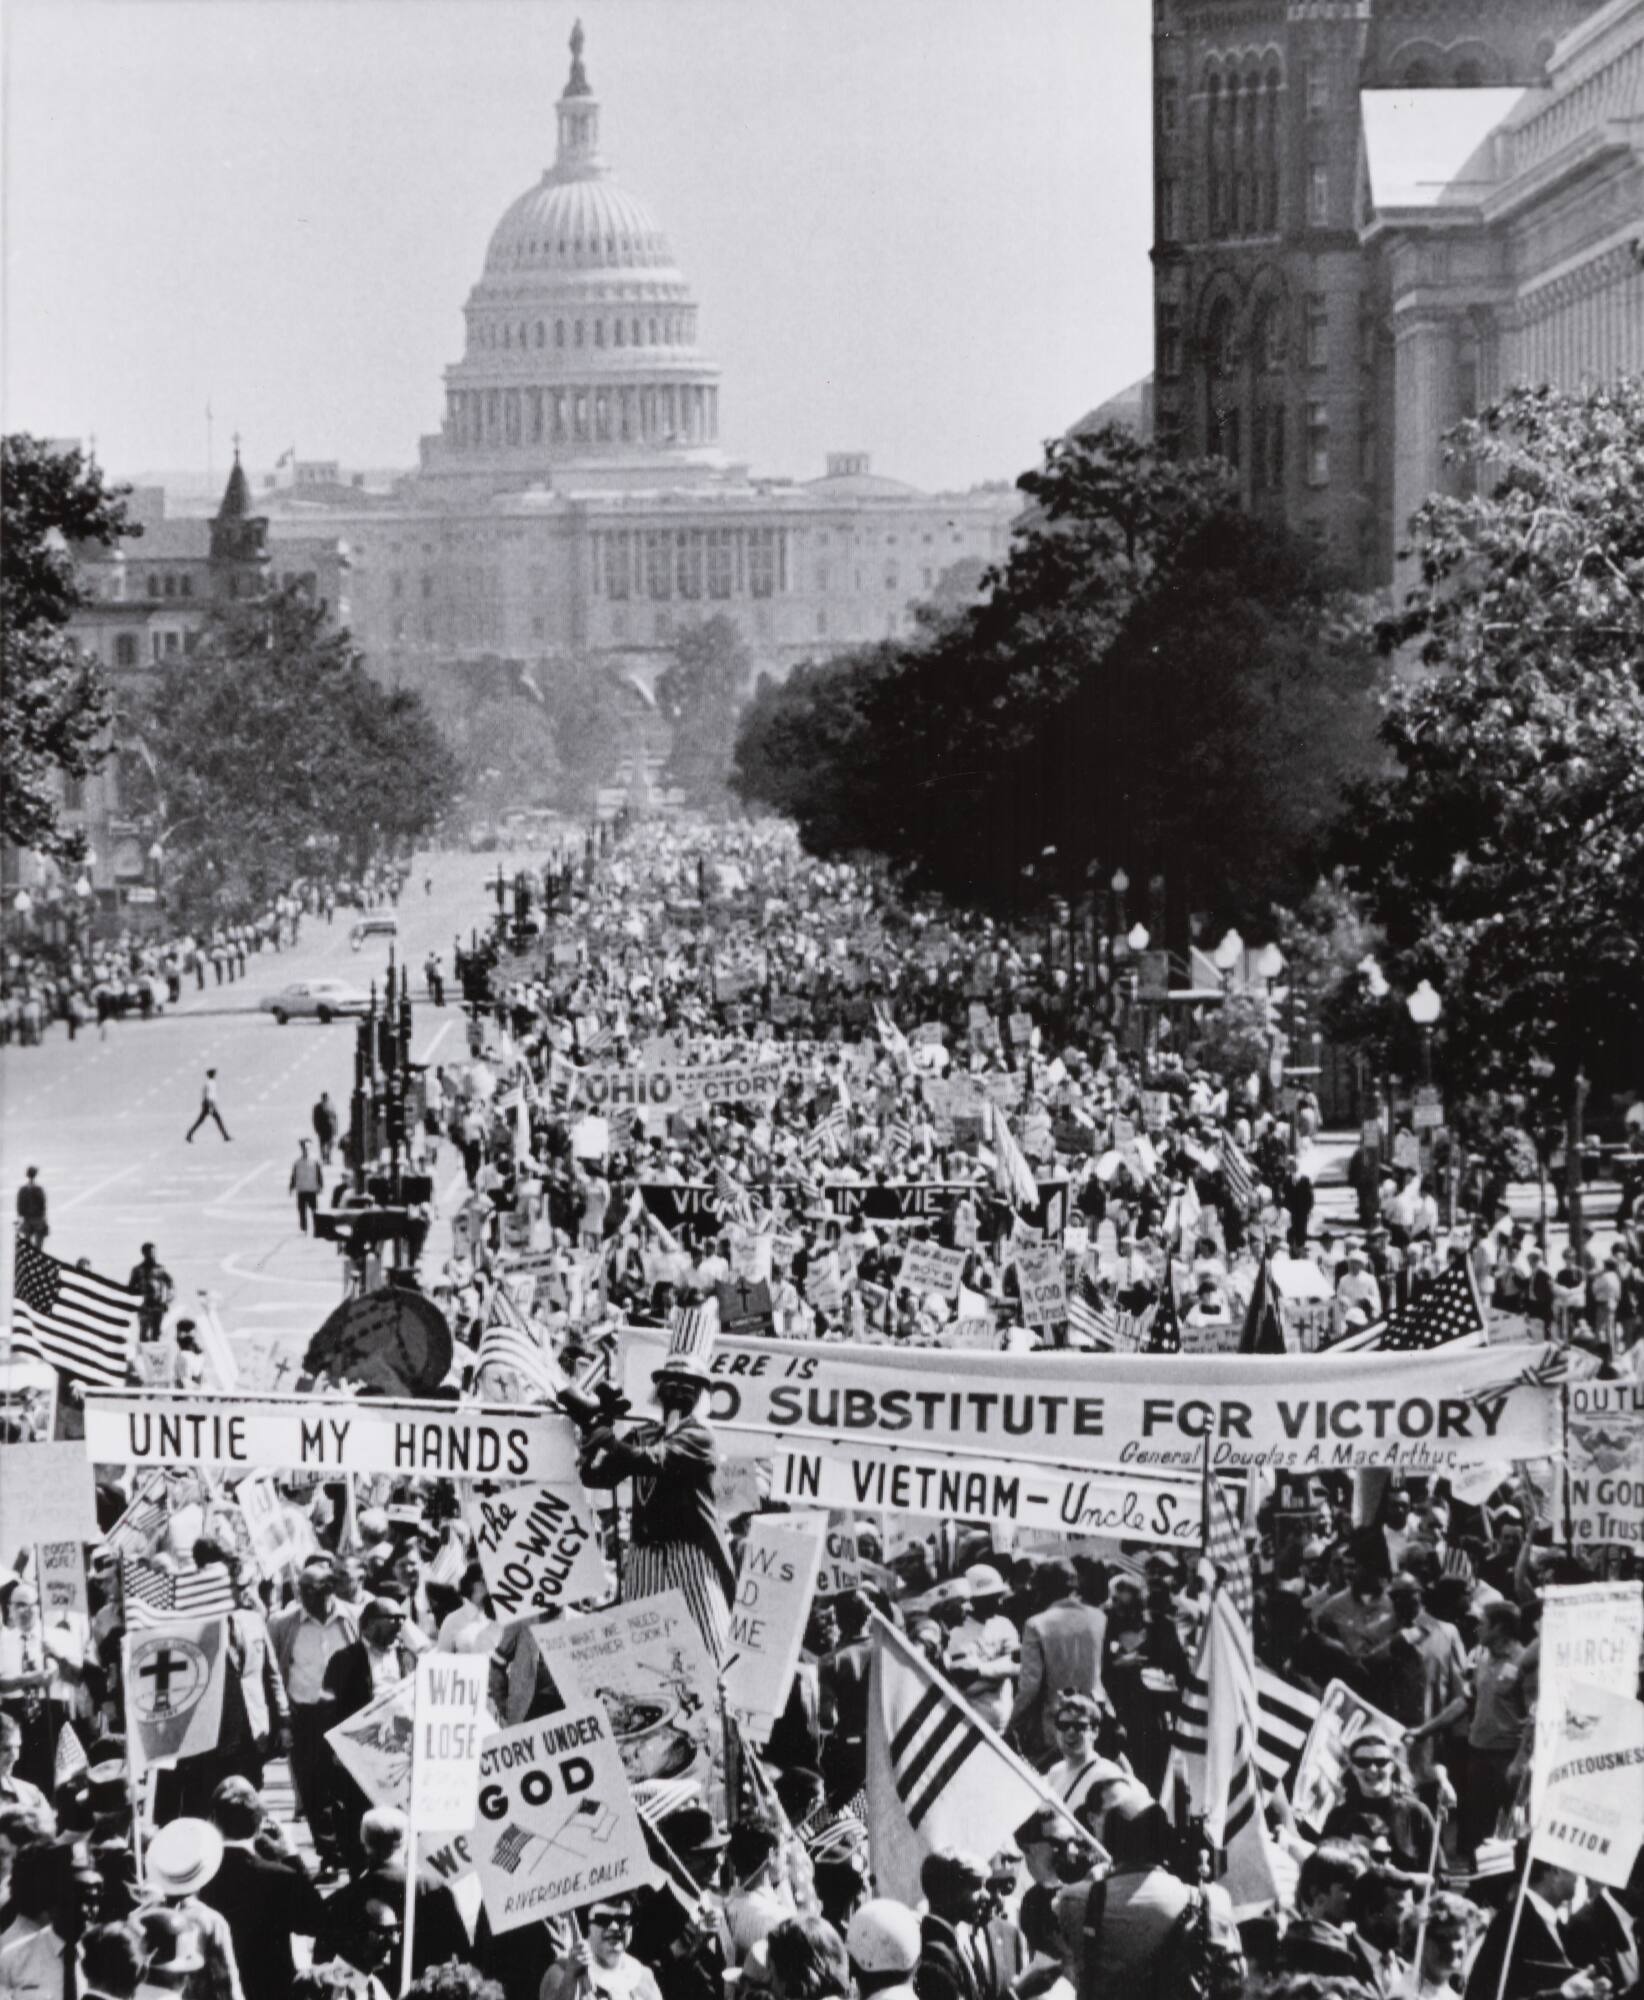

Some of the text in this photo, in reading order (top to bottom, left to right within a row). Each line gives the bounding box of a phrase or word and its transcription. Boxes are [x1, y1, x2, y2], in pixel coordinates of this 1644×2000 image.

[586, 1073, 672, 1103] OHIO
[709, 1353, 818, 1380] ERE IS
[707, 1380, 1509, 1439] O SUBSTITUTE FOR VICTORY
[129, 1412, 529, 1475] UNTIE MY HANDS
[1119, 1441, 1202, 1464] General
[1213, 1442, 1298, 1470] Douglas
[1305, 1444, 1325, 1465] A.
[785, 1453, 822, 1498] IN
[1061, 1481, 1144, 1531] Uncle
[1597, 1478, 1644, 1508] GOD
[478, 1502, 517, 1553] The
[491, 1489, 570, 1614] NO-WIN
[531, 1515, 589, 1608] POLICY
[627, 1610, 661, 1627] NEED
[428, 1668, 479, 1716] Why
[425, 1723, 477, 1760] LOSE
[543, 1715, 605, 1756] UNDER
[478, 1756, 595, 1821] GOD
